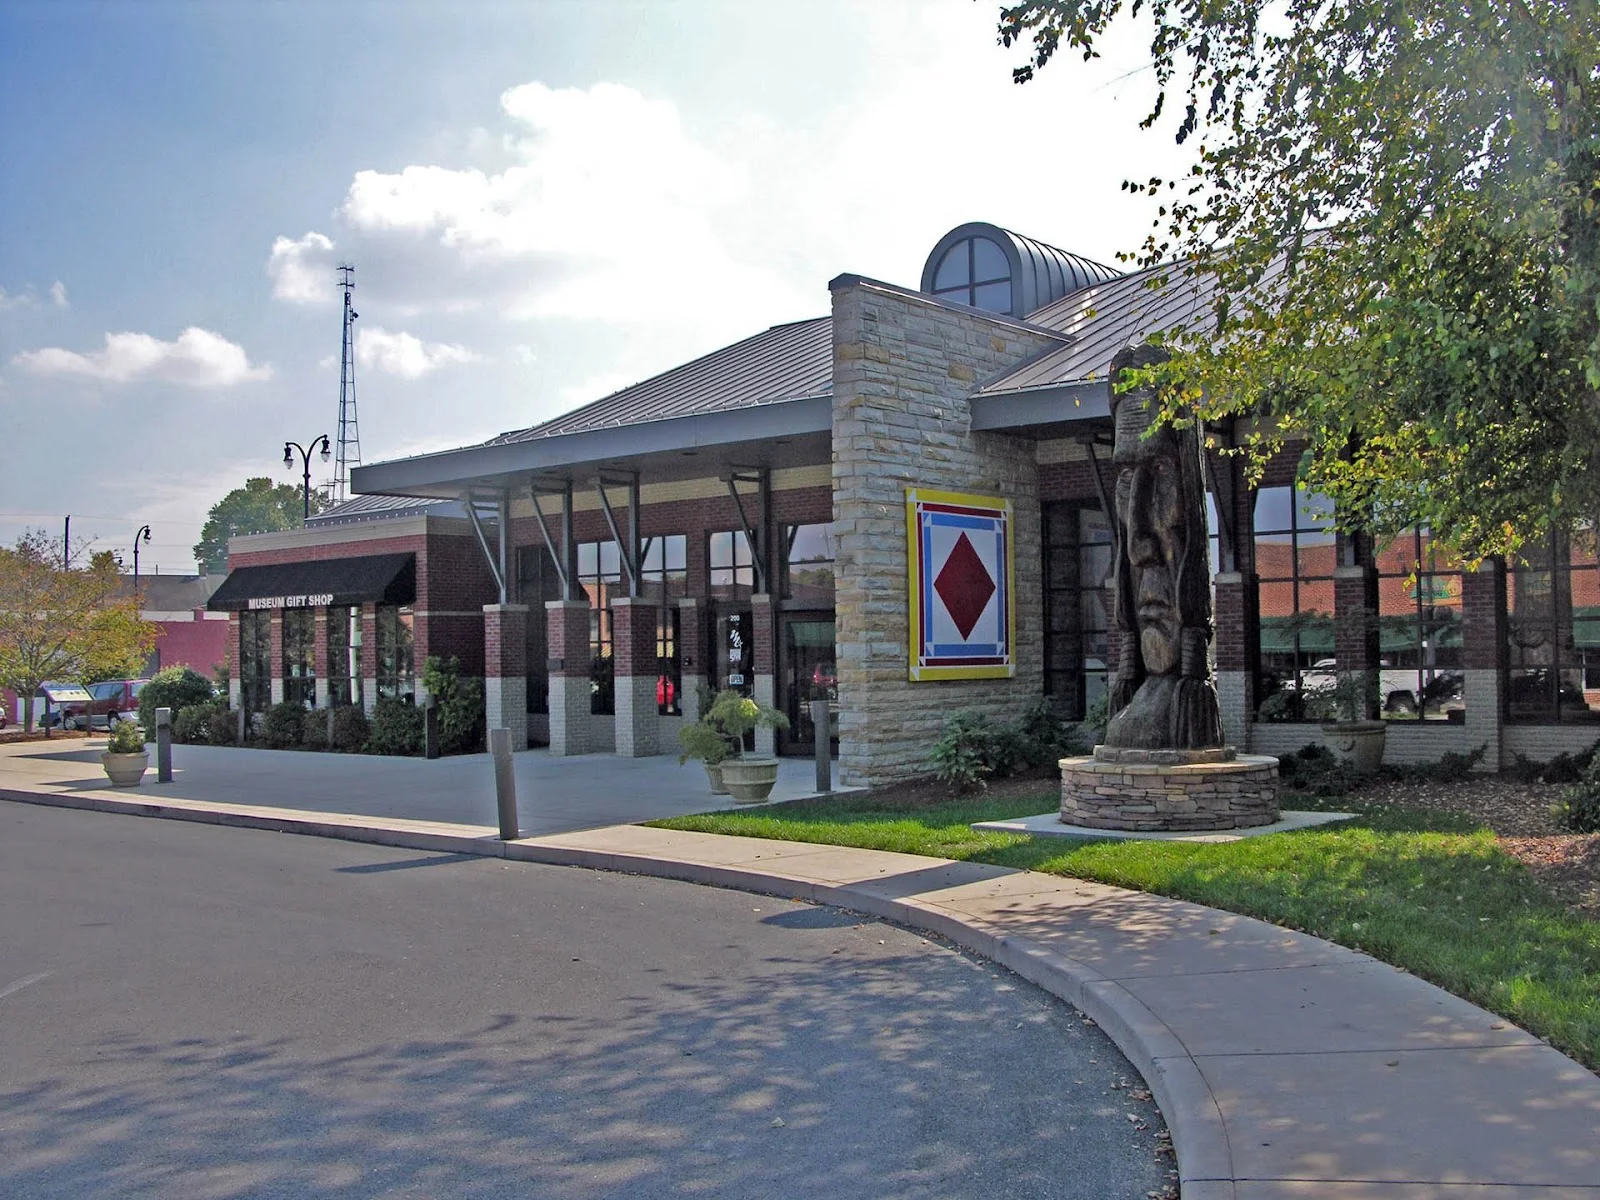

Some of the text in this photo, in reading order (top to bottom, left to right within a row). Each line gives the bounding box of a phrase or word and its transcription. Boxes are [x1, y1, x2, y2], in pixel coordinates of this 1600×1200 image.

[248, 594, 334, 609] MUSEUM GIFT SHOP
